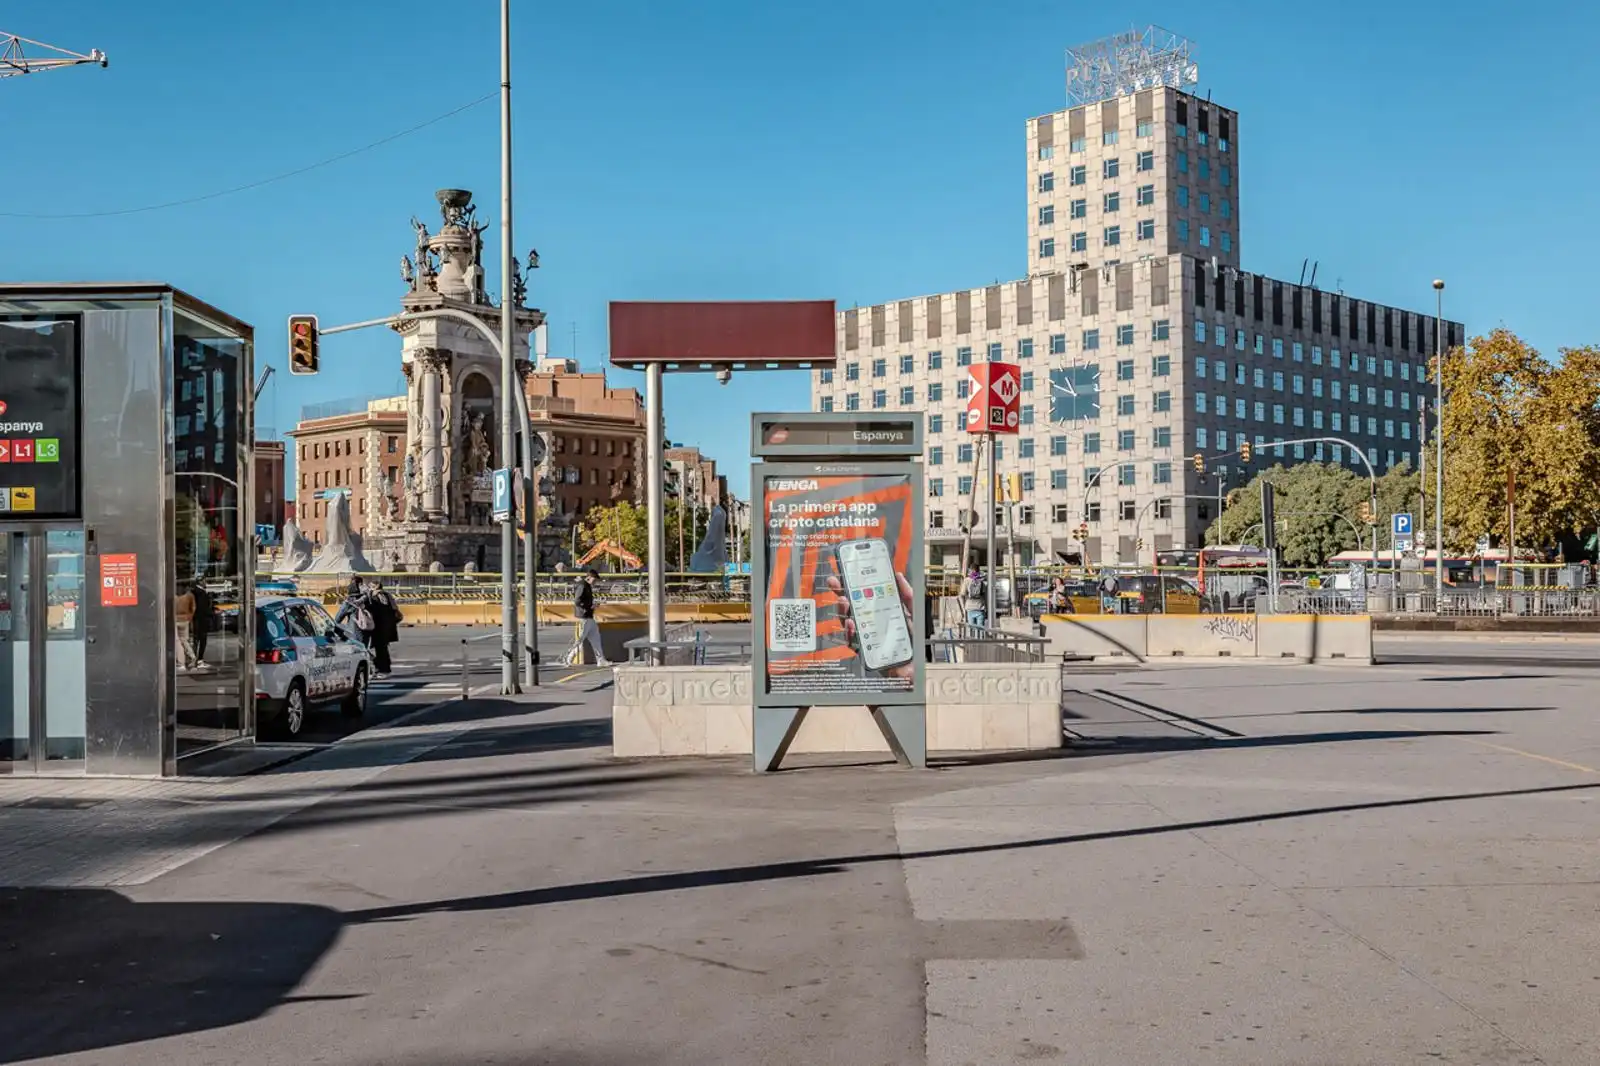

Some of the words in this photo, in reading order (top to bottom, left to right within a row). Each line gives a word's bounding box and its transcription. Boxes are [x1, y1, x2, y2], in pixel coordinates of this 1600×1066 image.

[1001, 379, 1013, 397] M
[853, 430, 904, 442] Espanya
[15, 443, 31, 457] L1
[38, 443, 57, 457] L3
[495, 474, 506, 508] P
[769, 480, 818, 491] VENGA
[769, 501, 786, 513] La
[788, 500, 847, 516] primera
[848, 502, 877, 515] app
[769, 515, 814, 530] cripto
[816, 515, 880, 528] catalana
[1397, 516, 1408, 532] P
